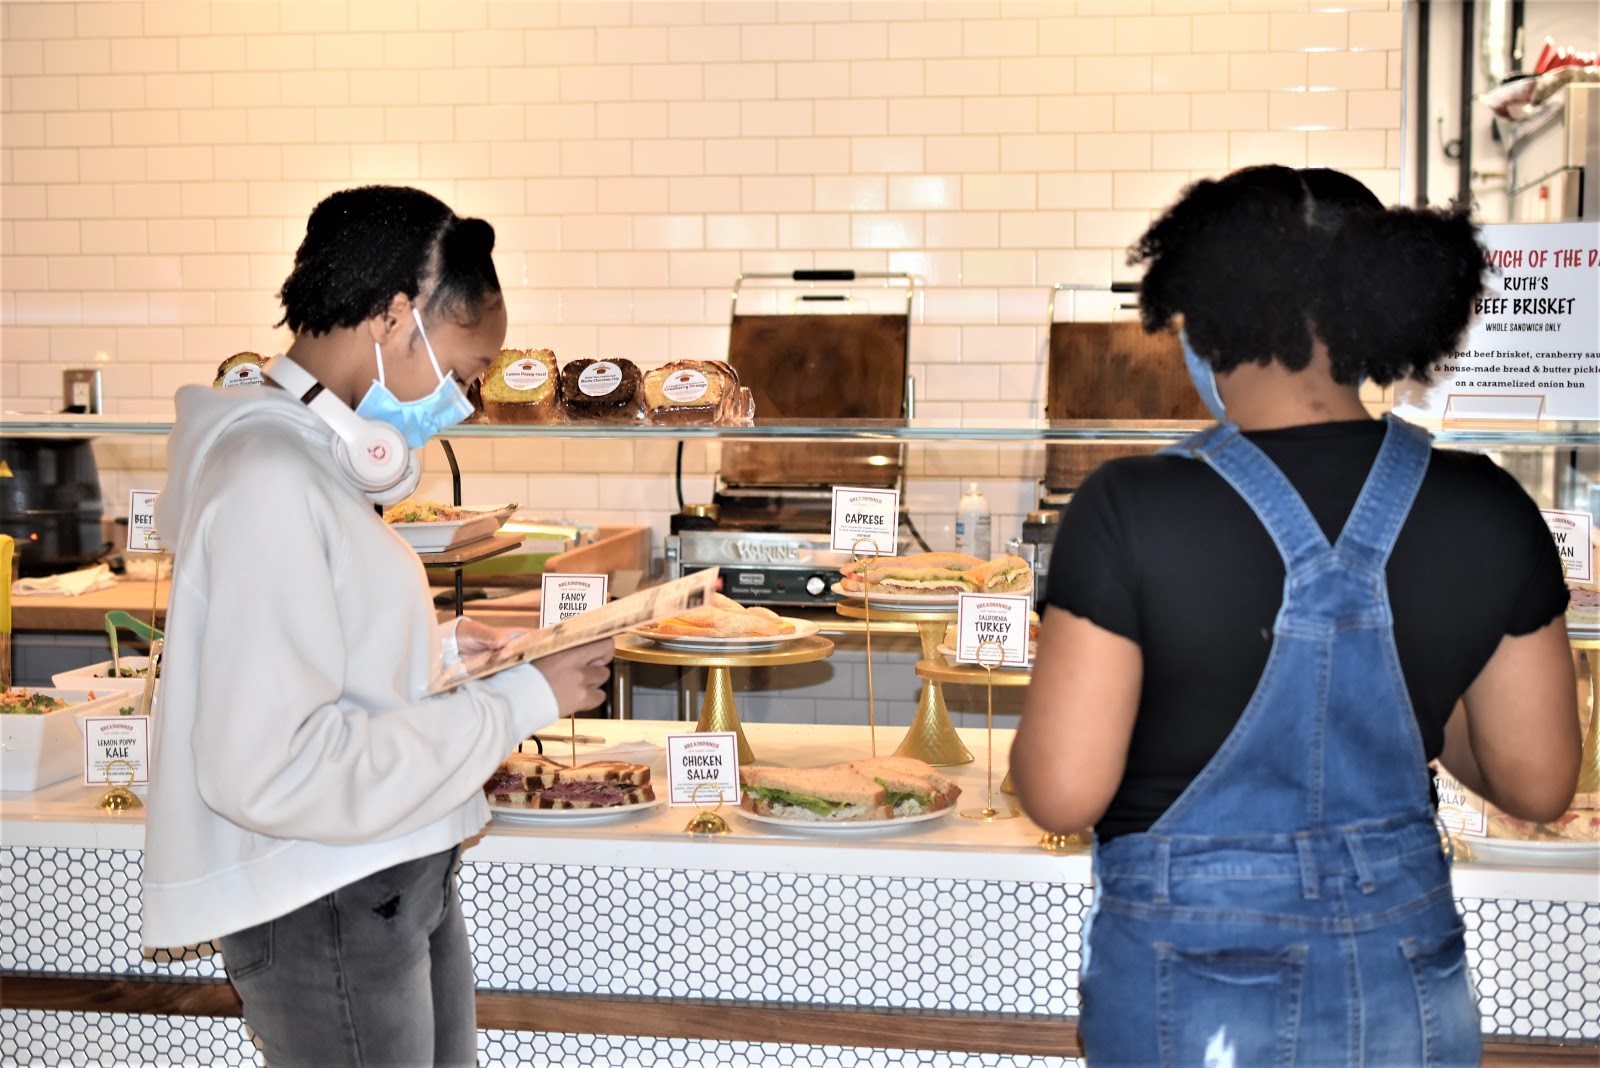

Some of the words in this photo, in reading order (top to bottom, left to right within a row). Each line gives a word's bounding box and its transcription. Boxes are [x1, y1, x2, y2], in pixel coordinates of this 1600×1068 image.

[1482, 249, 1522, 268] WICH
[1528, 250, 1548, 268] OF
[1553, 249, 1583, 268] THE
[1504, 277, 1549, 290] RUTH'S
[1474, 298, 1508, 315] BEEF
[1513, 298, 1575, 315] BRISKET
[1485, 323, 1508, 332] WHOLE
[1510, 323, 1543, 332] SANDWICH
[1545, 323, 1561, 332] ONLY
[1474, 350, 1495, 358] beef
[1496, 350, 1533, 360] brisket,
[1535, 351, 1583, 361] cranberry
[1444, 364, 1501, 373] house-made
[1503, 365, 1530, 373] bread
[1532, 365, 1540, 373] &
[1543, 365, 1571, 374] butter
[1476, 379, 1536, 388] caramelized
[1538, 380, 1565, 388] onion
[1567, 380, 1585, 388] bun
[134, 514, 153, 525] BEET
[845, 513, 885, 525] CAPRESE
[736, 540, 801, 562] WARING
[561, 592, 586, 601] FANCY
[558, 602, 588, 611] GRILLED
[978, 614, 1008, 622] CALIFORNIA
[975, 621, 1012, 633] TURKEY
[977, 634, 1008, 646] WRAP
[97, 739, 118, 747] LEMON
[119, 738, 137, 746] POPPY
[105, 747, 129, 758] KALE
[682, 755, 723, 767] CHICKEN
[687, 769, 720, 781] SALAD
[1435, 778, 1464, 792] TUNA
[1438, 793, 1466, 806] ALAD
